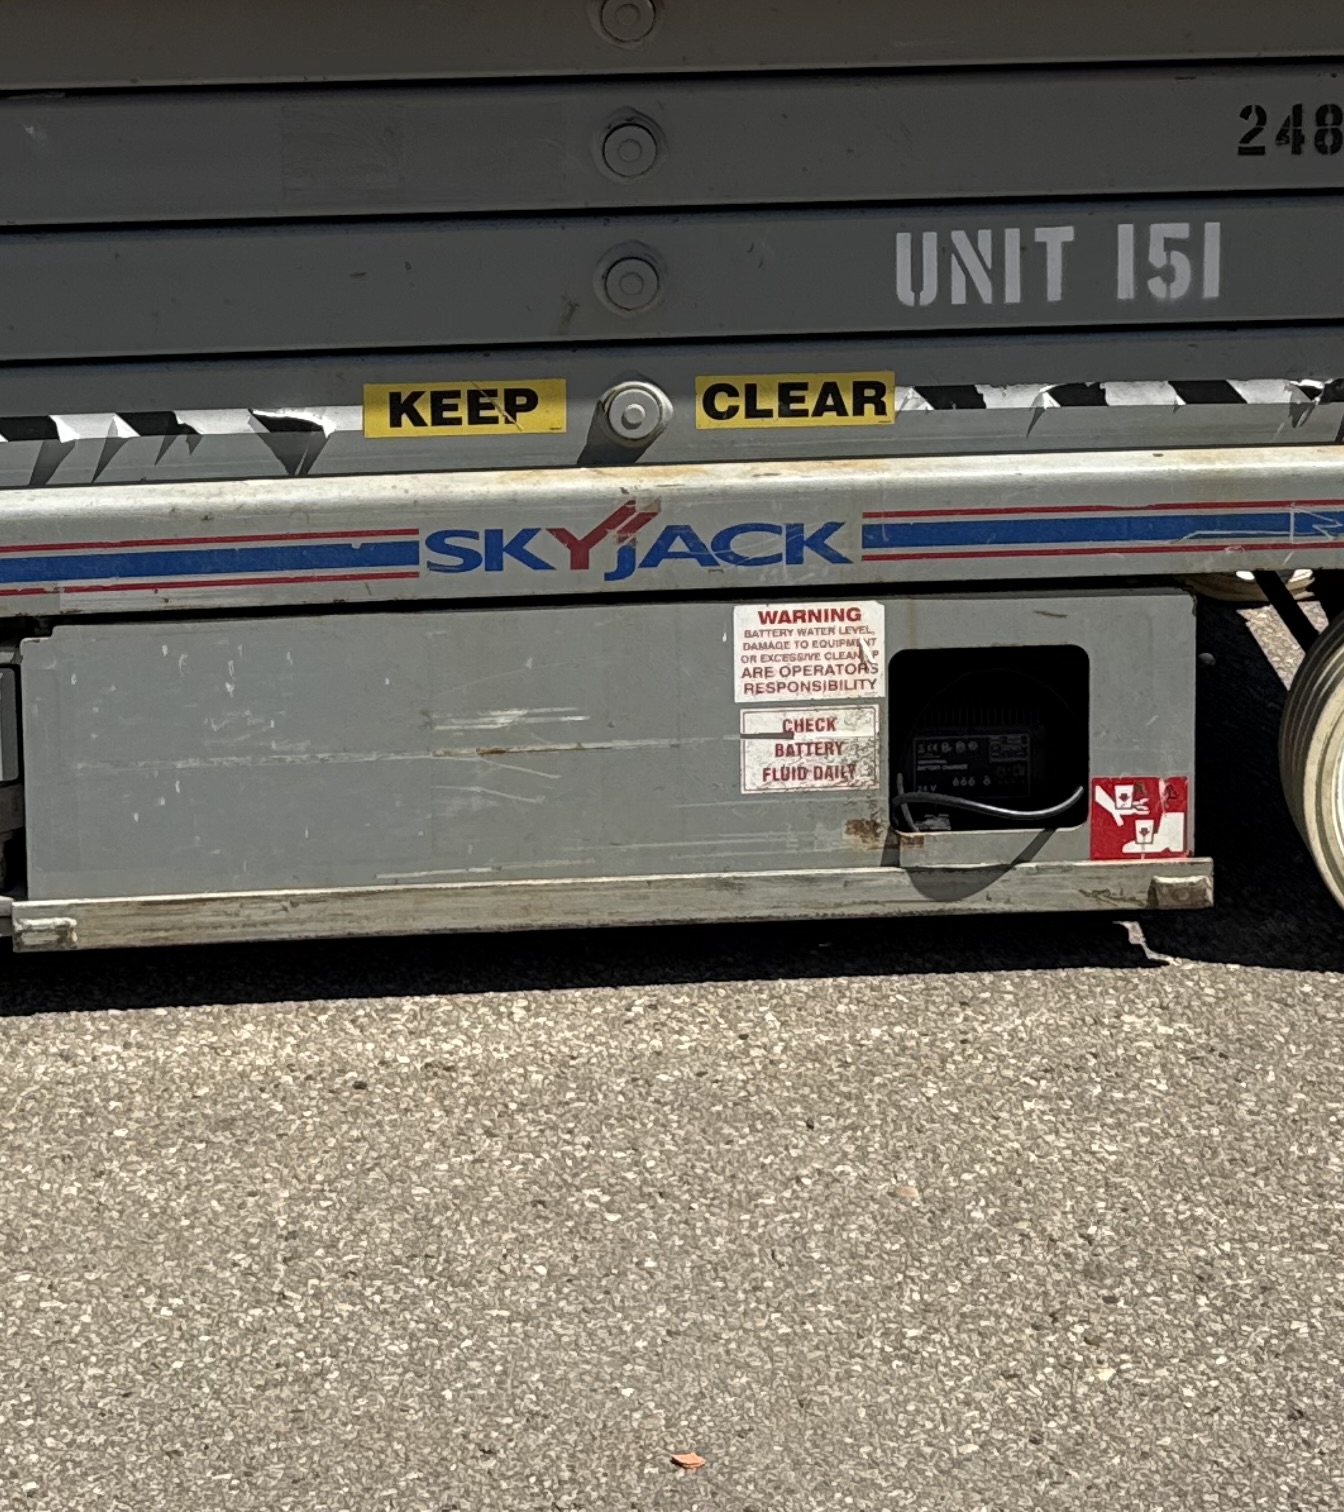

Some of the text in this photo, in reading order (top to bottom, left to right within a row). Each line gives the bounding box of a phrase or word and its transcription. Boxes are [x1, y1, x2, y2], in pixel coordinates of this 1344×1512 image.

[896, 222, 1221, 307] UNIT 151
[389, 381, 887, 428] KEEP CLEAR
[425, 499, 854, 582] SKYJACK
[758, 607, 862, 625] WARNING
[744, 625, 875, 638] BATTERY WATER LEVEL,
[743, 641, 791, 651] DAMAGE
[794, 640, 809, 649] TO
[741, 655, 757, 664] OR
[760, 652, 821, 663] EXCESSIVE
[741, 663, 878, 679] ARE OPERATORS
[744, 678, 877, 695] RESPONSIBILITY
[782, 717, 837, 734] CHECK
[775, 741, 845, 757] BATTERY
[762, 764, 856, 782] FLUID DAILY
